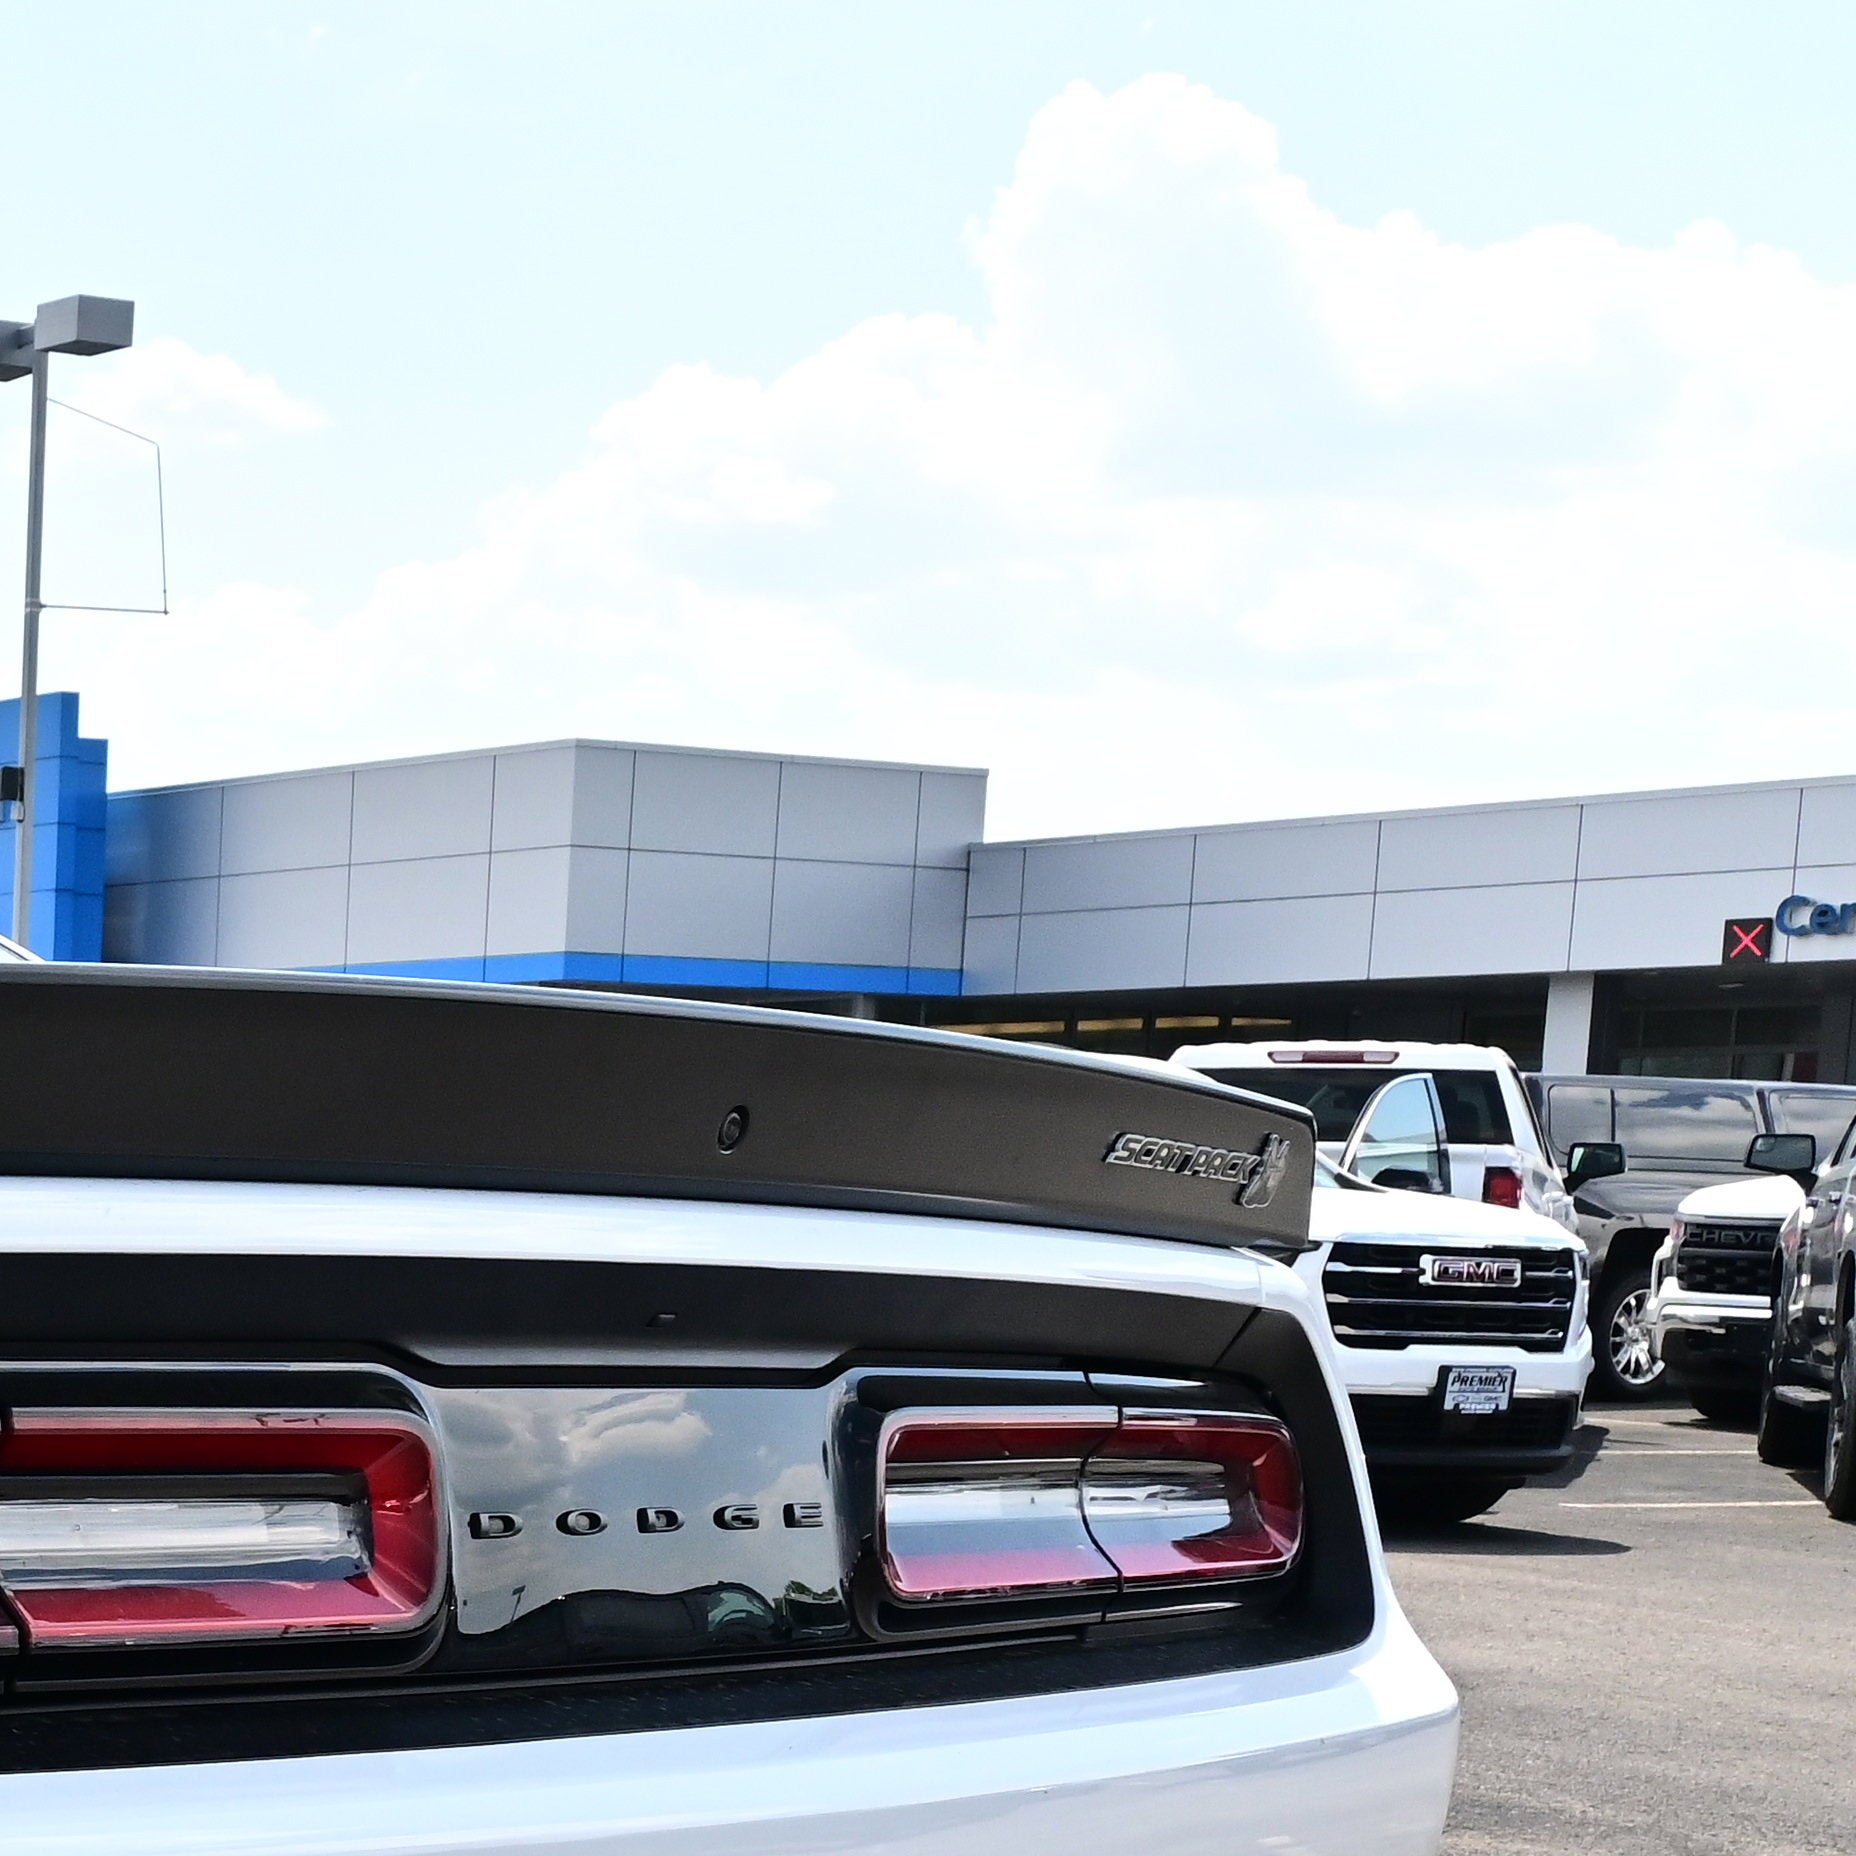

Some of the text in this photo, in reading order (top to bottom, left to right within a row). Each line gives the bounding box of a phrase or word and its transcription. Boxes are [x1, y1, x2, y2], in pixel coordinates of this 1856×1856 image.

[1434, 1259, 1518, 1283] GMC
[1451, 1375, 1508, 1388] PREMIER
[468, 1502, 824, 1540] DODGE
